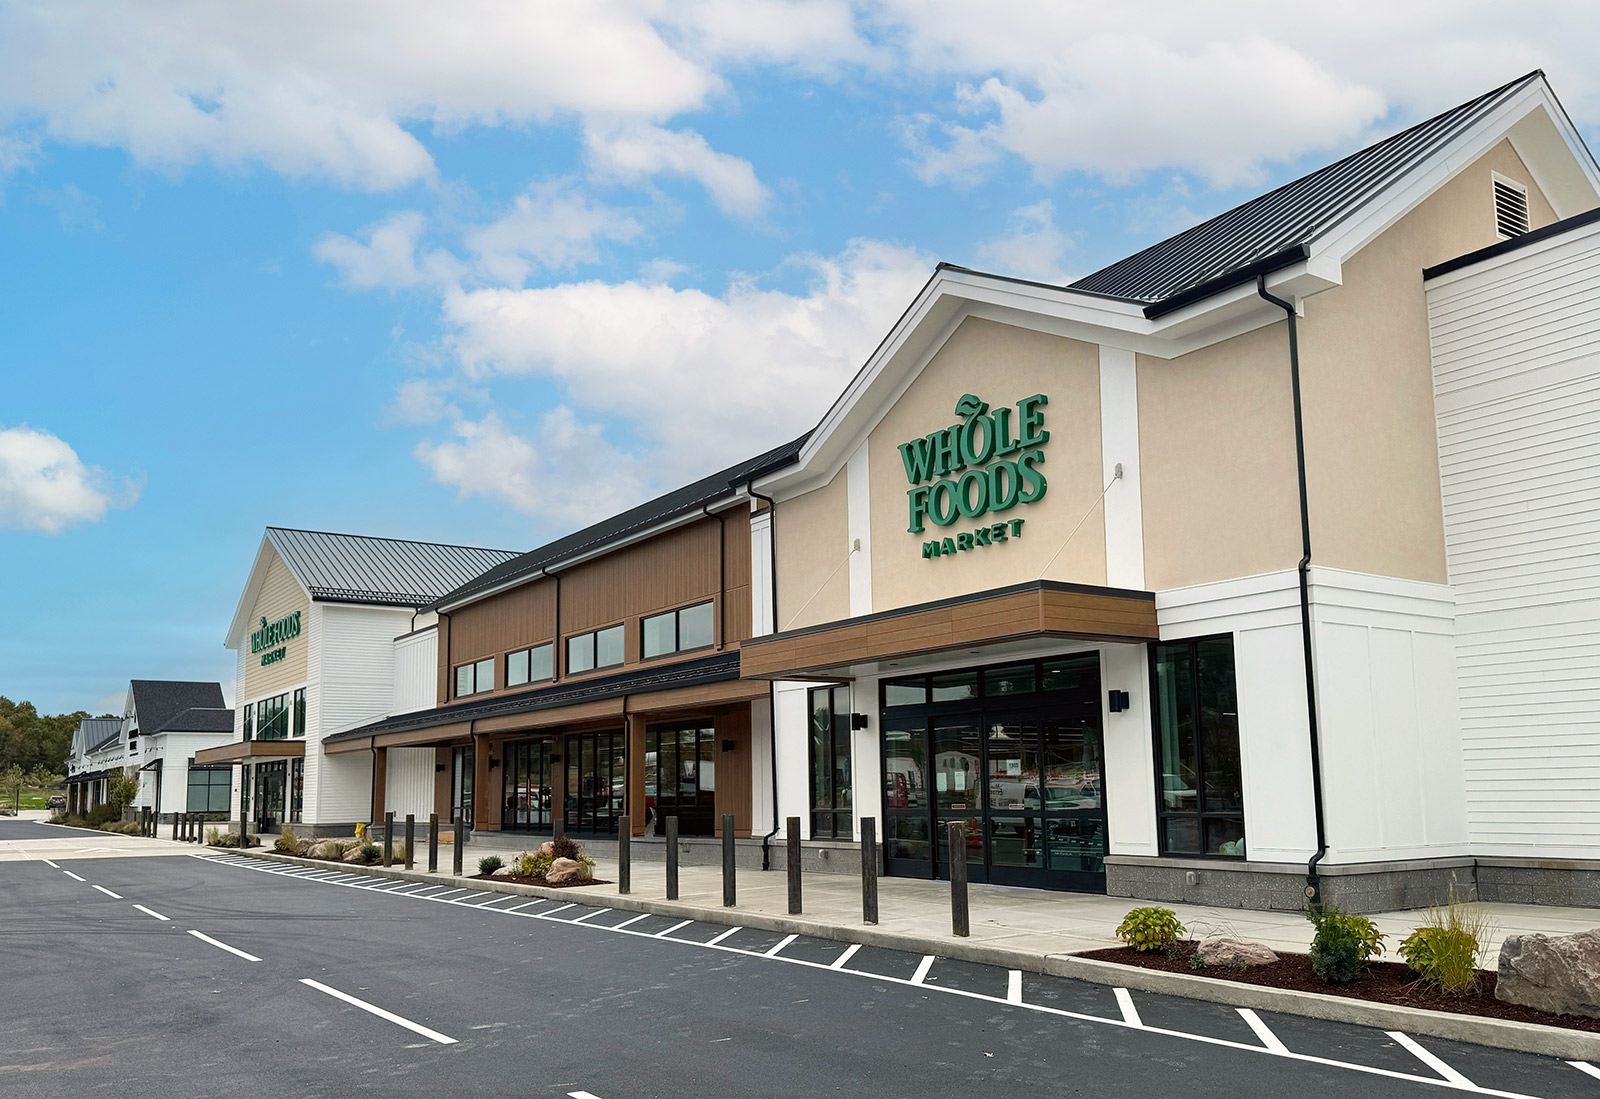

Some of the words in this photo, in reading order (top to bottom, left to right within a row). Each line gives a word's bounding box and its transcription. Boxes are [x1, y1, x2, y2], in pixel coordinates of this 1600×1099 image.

[897, 394, 1050, 485] WHOLE
[907, 450, 1047, 533] FOODS
[922, 519, 1025, 559] MARKET
[274, 611, 301, 644] FOODS
